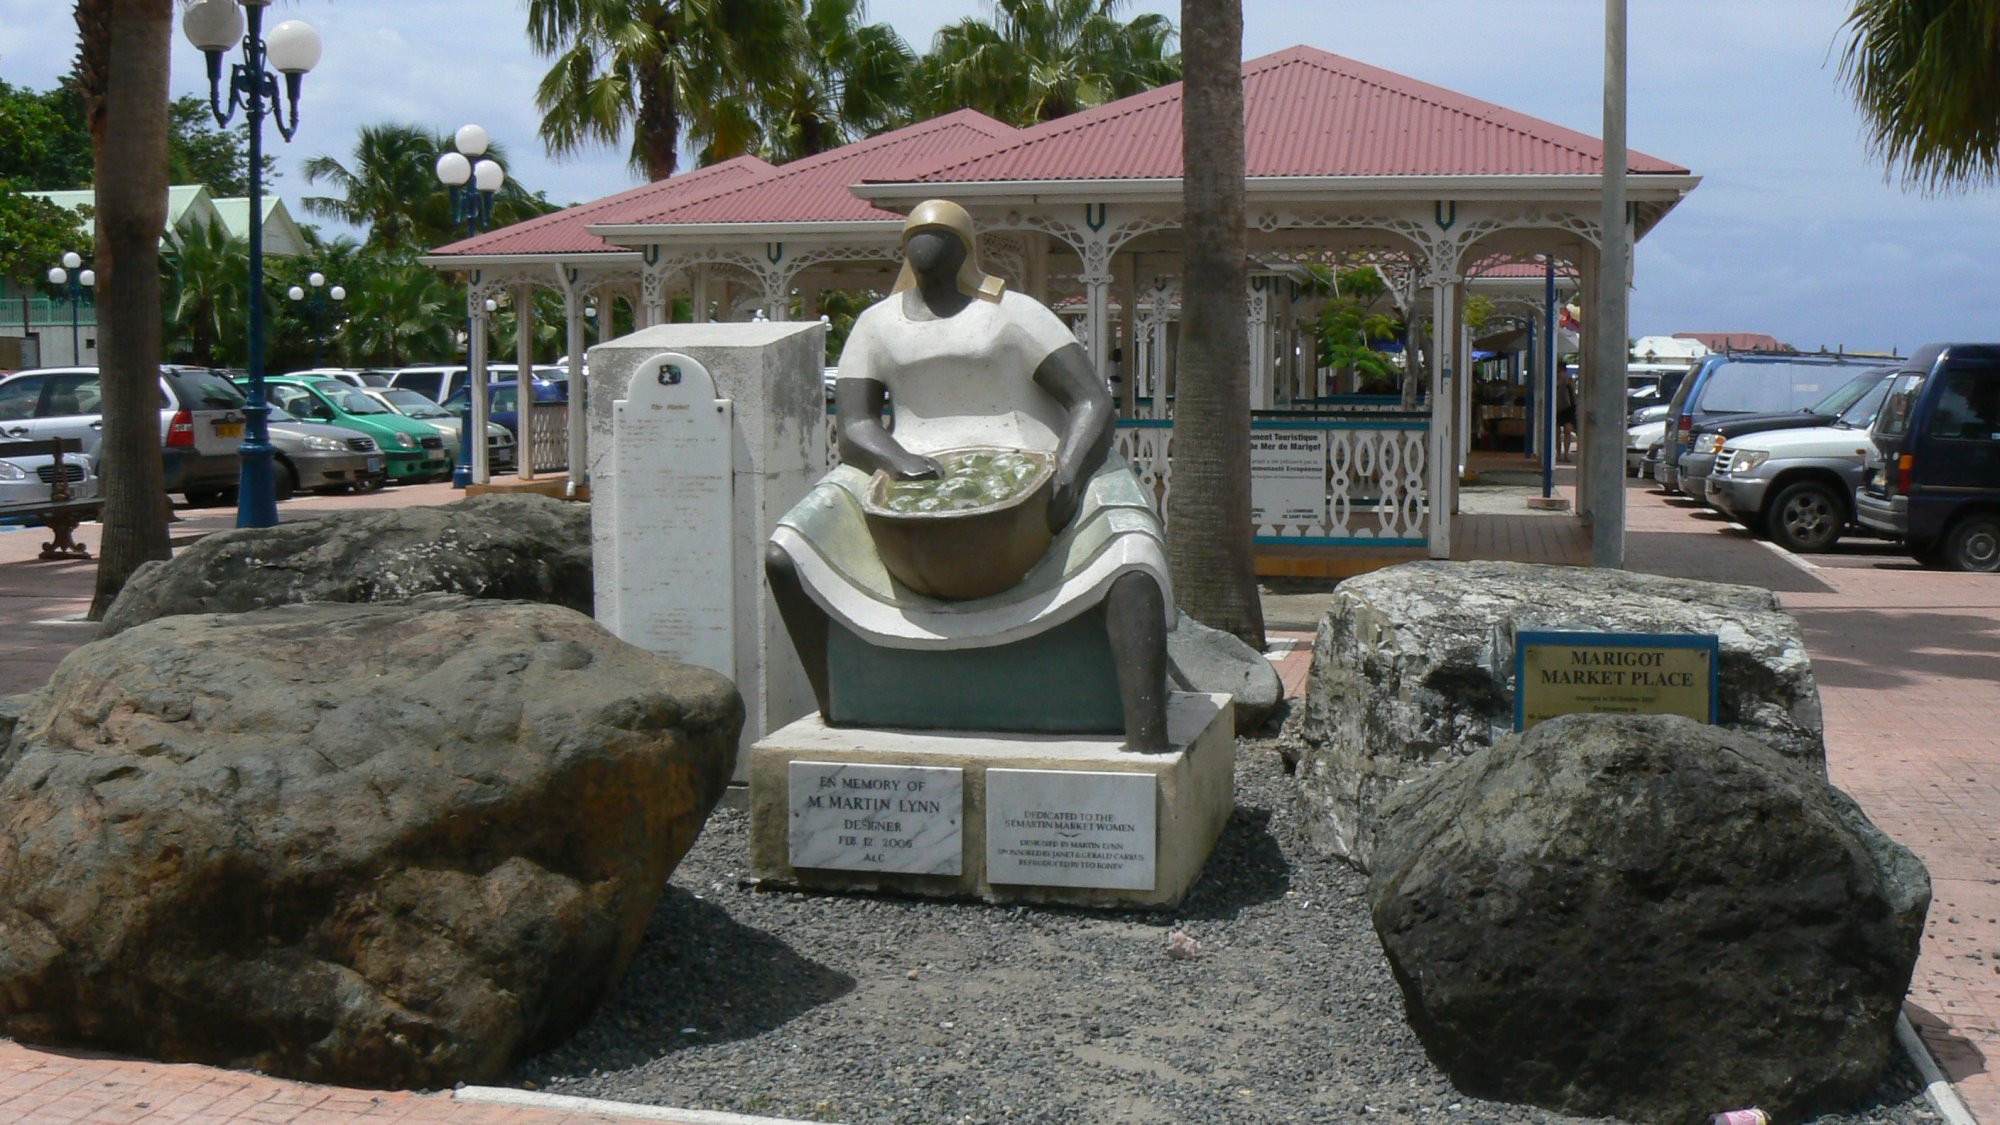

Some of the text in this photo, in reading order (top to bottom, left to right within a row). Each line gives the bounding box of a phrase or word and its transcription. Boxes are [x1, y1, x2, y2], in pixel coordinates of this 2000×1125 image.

[1274, 433, 1318, 442] Touristique
[1290, 443, 1321, 452] Marigot
[1571, 651, 1664, 667] MARIGOT
[1541, 669, 1693, 687] MARKET PLACE
[843, 778, 900, 792] MEMORY
[907, 781, 925, 792] OF
[829, 797, 890, 811] MARTIN
[898, 799, 940, 813] LYNN
[1024, 811, 1114, 822] DEDICATED TO THE
[844, 819, 902, 832] DESIGNER
[1054, 822, 1094, 831] MARKET
[1096, 824, 1136, 832] WOMEN
[882, 838, 913, 849] 2006
